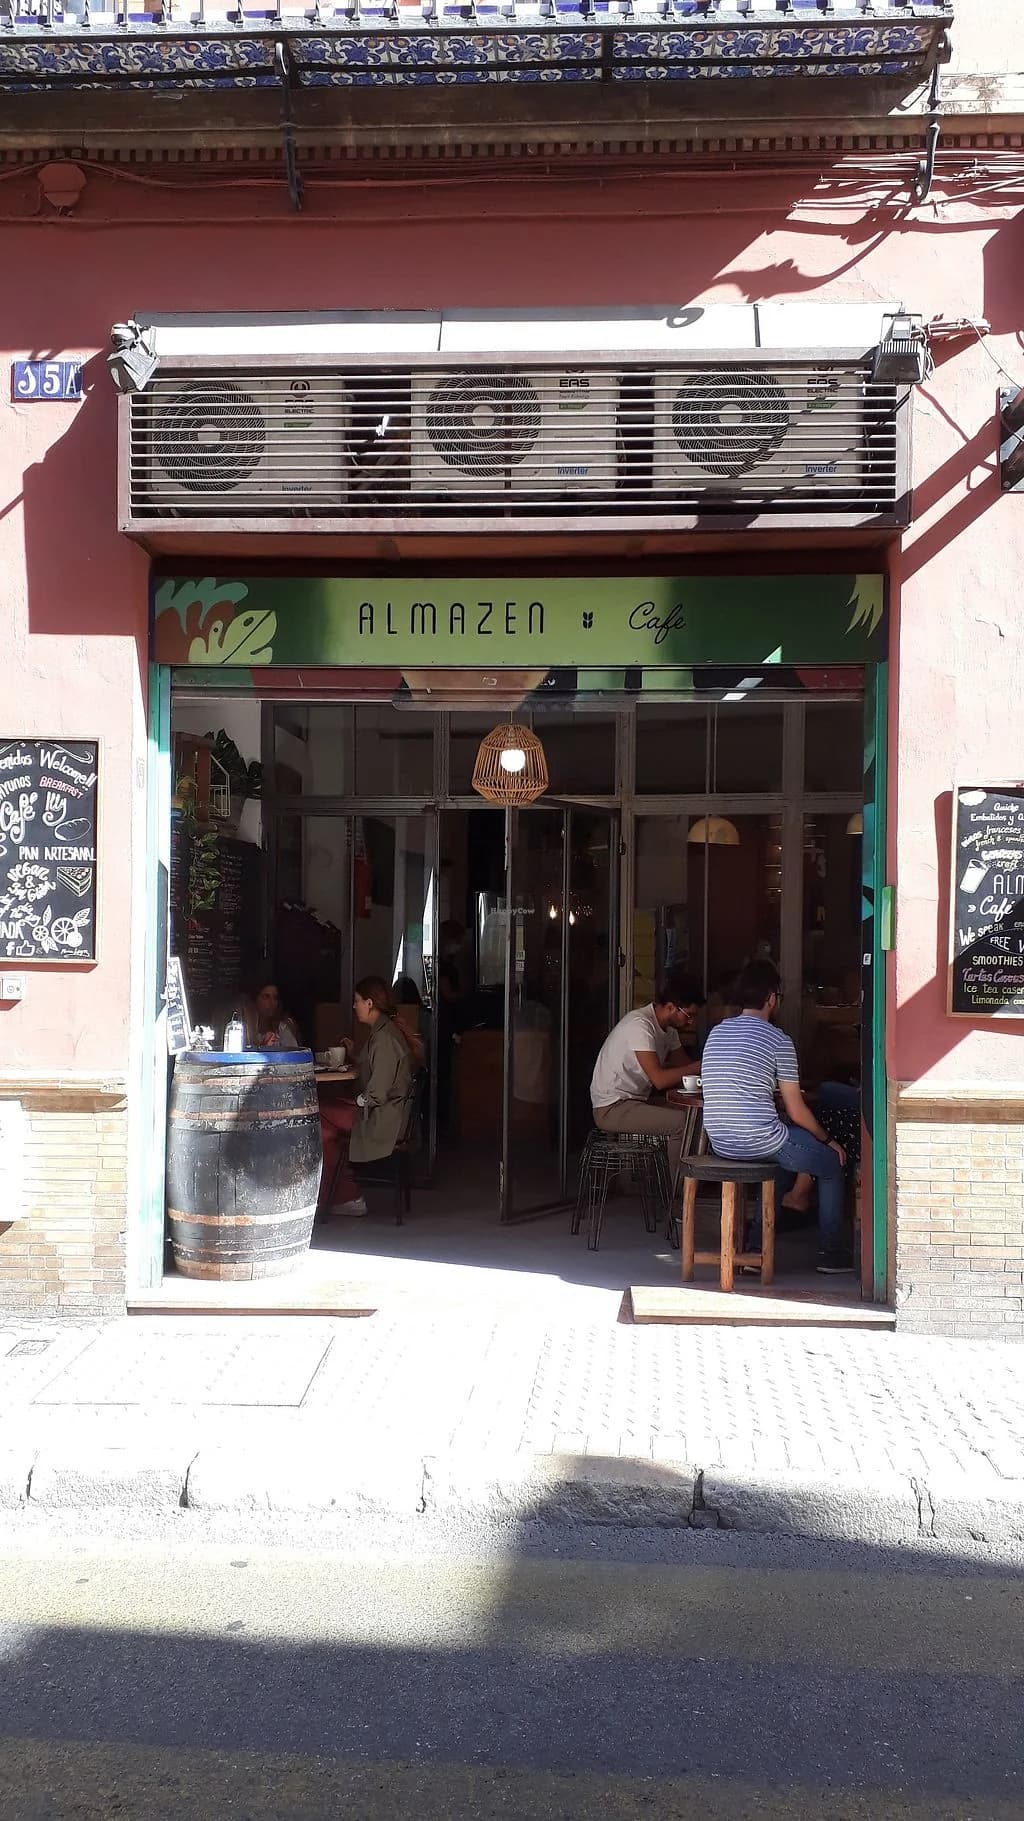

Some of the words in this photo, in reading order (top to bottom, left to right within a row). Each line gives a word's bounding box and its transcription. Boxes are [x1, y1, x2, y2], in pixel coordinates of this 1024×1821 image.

[560, 378, 590, 388] EAS
[557, 466, 588, 475] Inverter
[805, 464, 837, 473] Inverter
[358, 602, 545, 635] ALMAZEN
[39, 776, 84, 800] BREAKFAST
[45, 846, 97, 860] ARTESANAL
[990, 936, 1012, 950] FREE
[972, 955, 1024, 967] SMOOTHIES
[963, 982, 978, 993] Ice
[982, 983, 999, 994] tea
